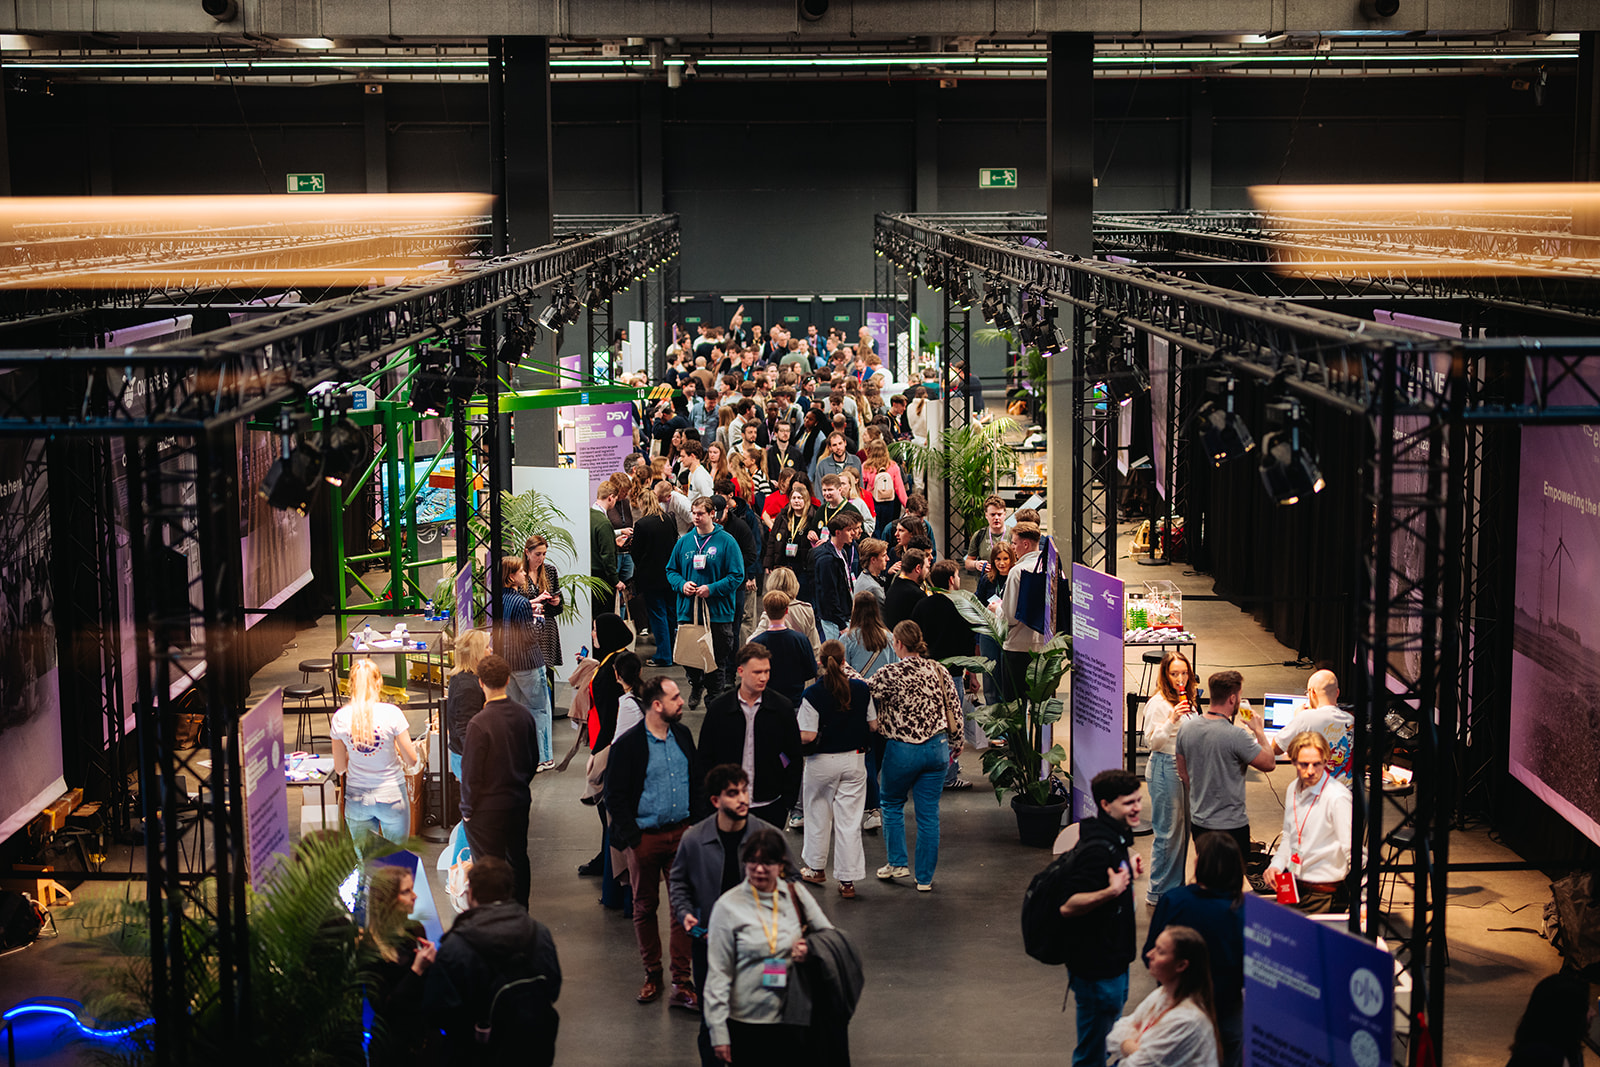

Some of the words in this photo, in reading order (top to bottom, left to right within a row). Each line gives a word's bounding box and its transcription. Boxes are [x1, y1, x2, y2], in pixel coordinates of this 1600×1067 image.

[636, 388, 645, 399] 10
[606, 411, 628, 420] DSV
[1544, 480, 1584, 514] Empowering
[1585, 497, 1597, 516] the
